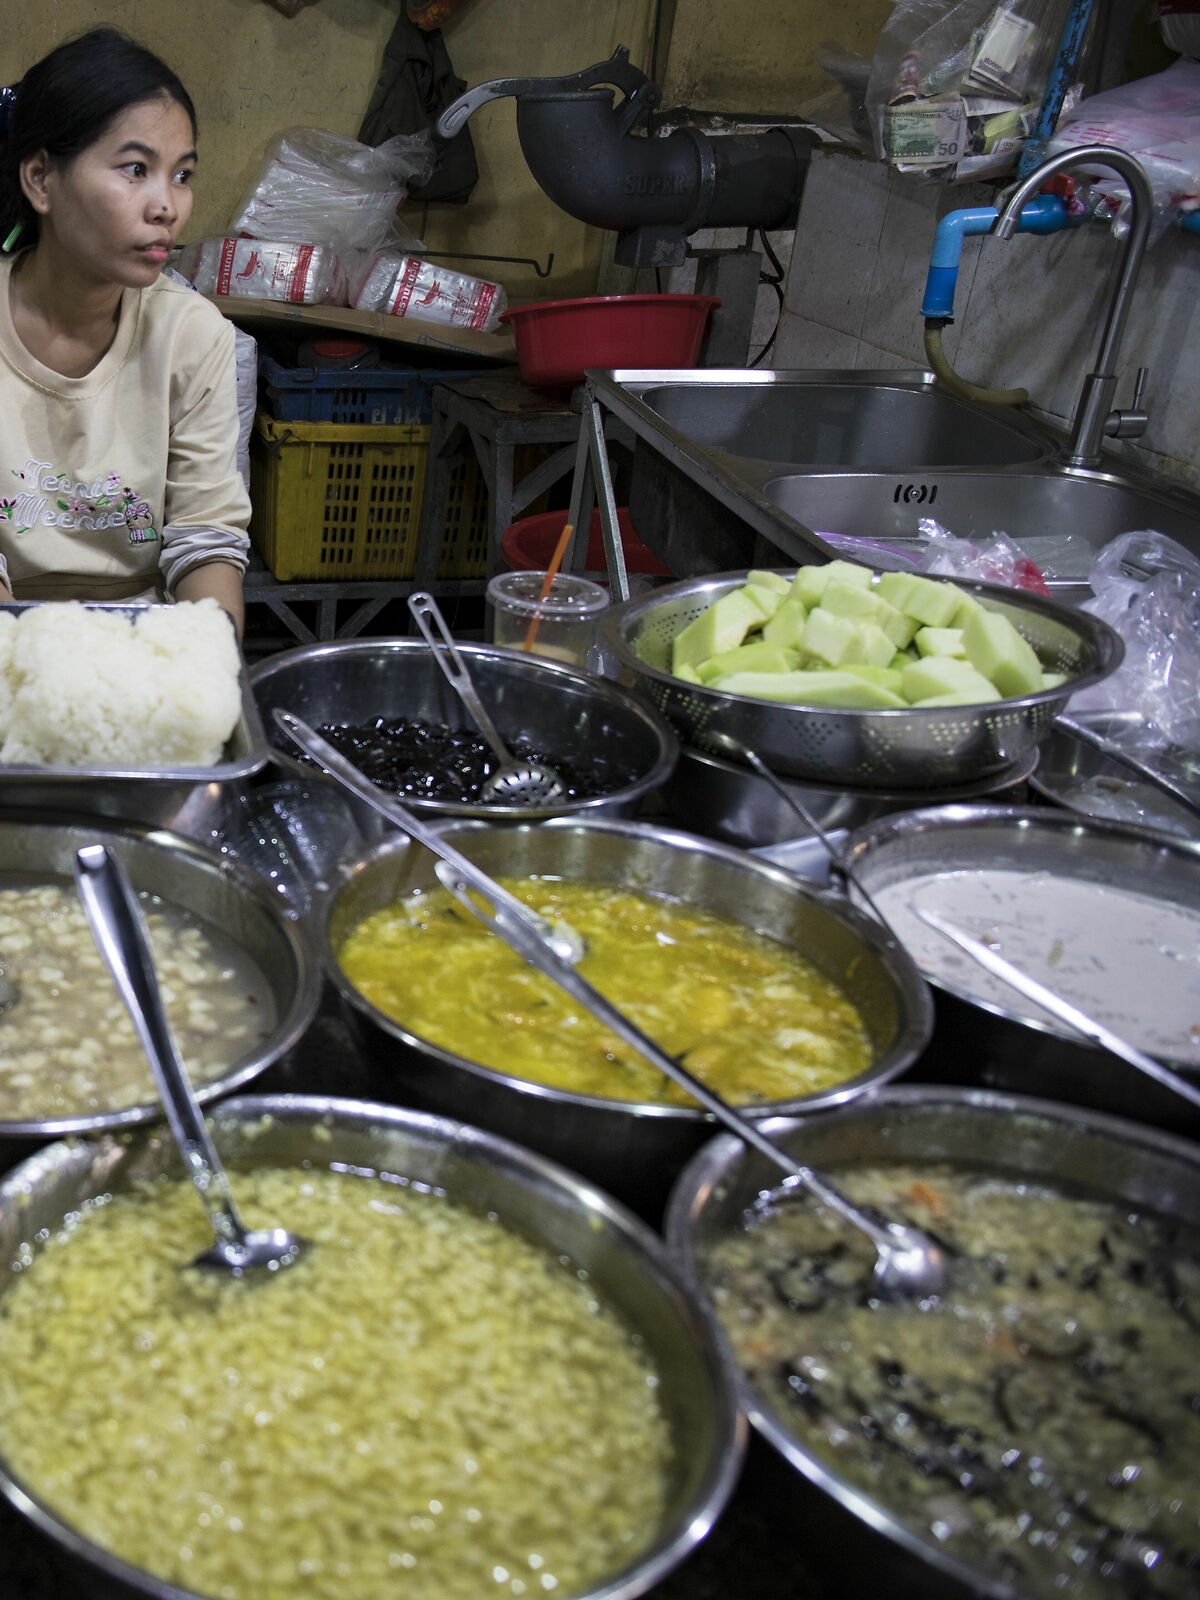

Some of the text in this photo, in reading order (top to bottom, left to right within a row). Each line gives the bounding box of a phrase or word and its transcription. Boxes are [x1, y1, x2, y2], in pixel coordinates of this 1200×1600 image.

[938, 142, 958, 156] 50
[623, 175, 686, 195] SUPER
[23, 459, 120, 498] Teenie
[14, 493, 126, 529] Weenie
